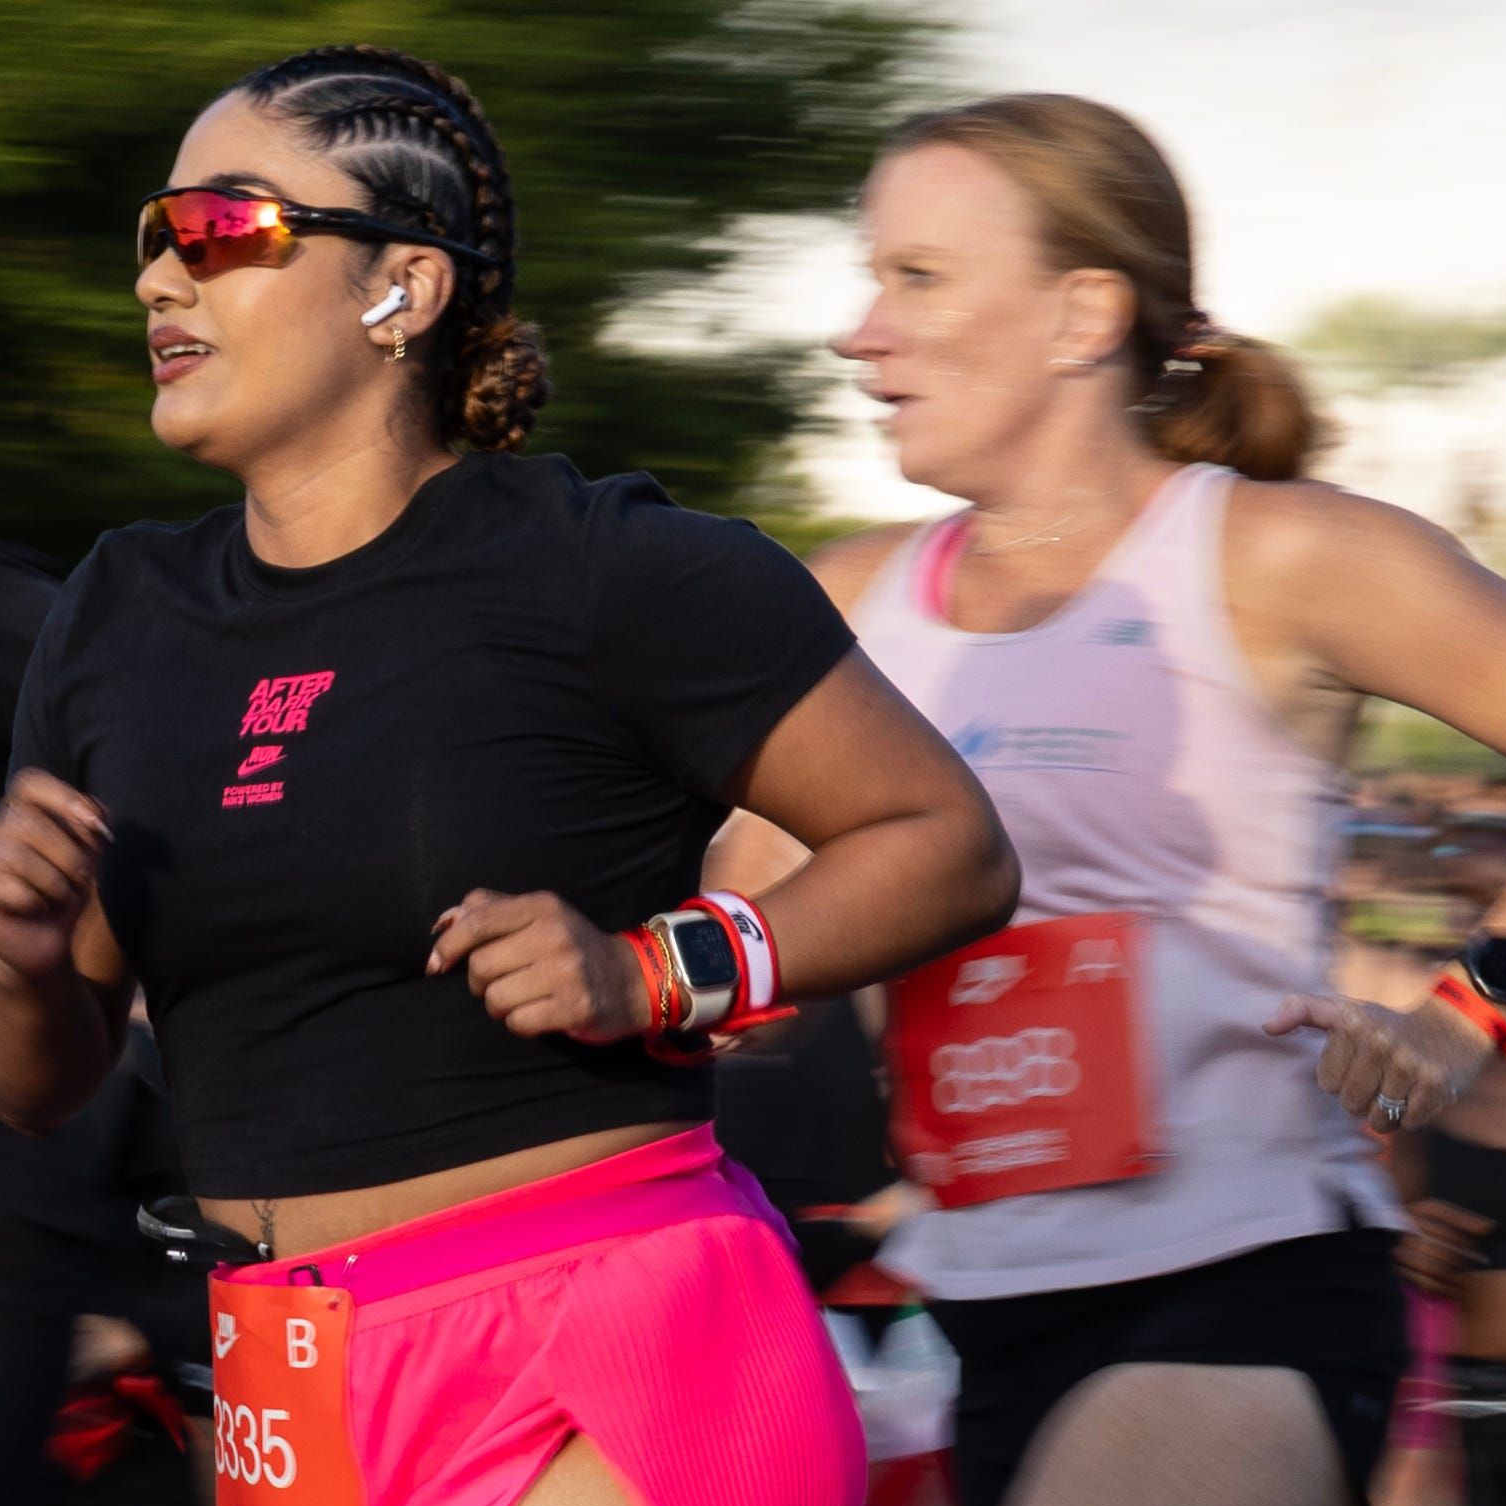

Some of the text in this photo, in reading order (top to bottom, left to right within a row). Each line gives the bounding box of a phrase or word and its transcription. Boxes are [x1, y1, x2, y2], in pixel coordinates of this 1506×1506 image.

[248, 671, 335, 702] AFTER
[244, 692, 320, 718] DARK
[239, 709, 309, 738] TOUR
[223, 781, 285, 798] POWERED BY
[286, 1318, 318, 1369] B
